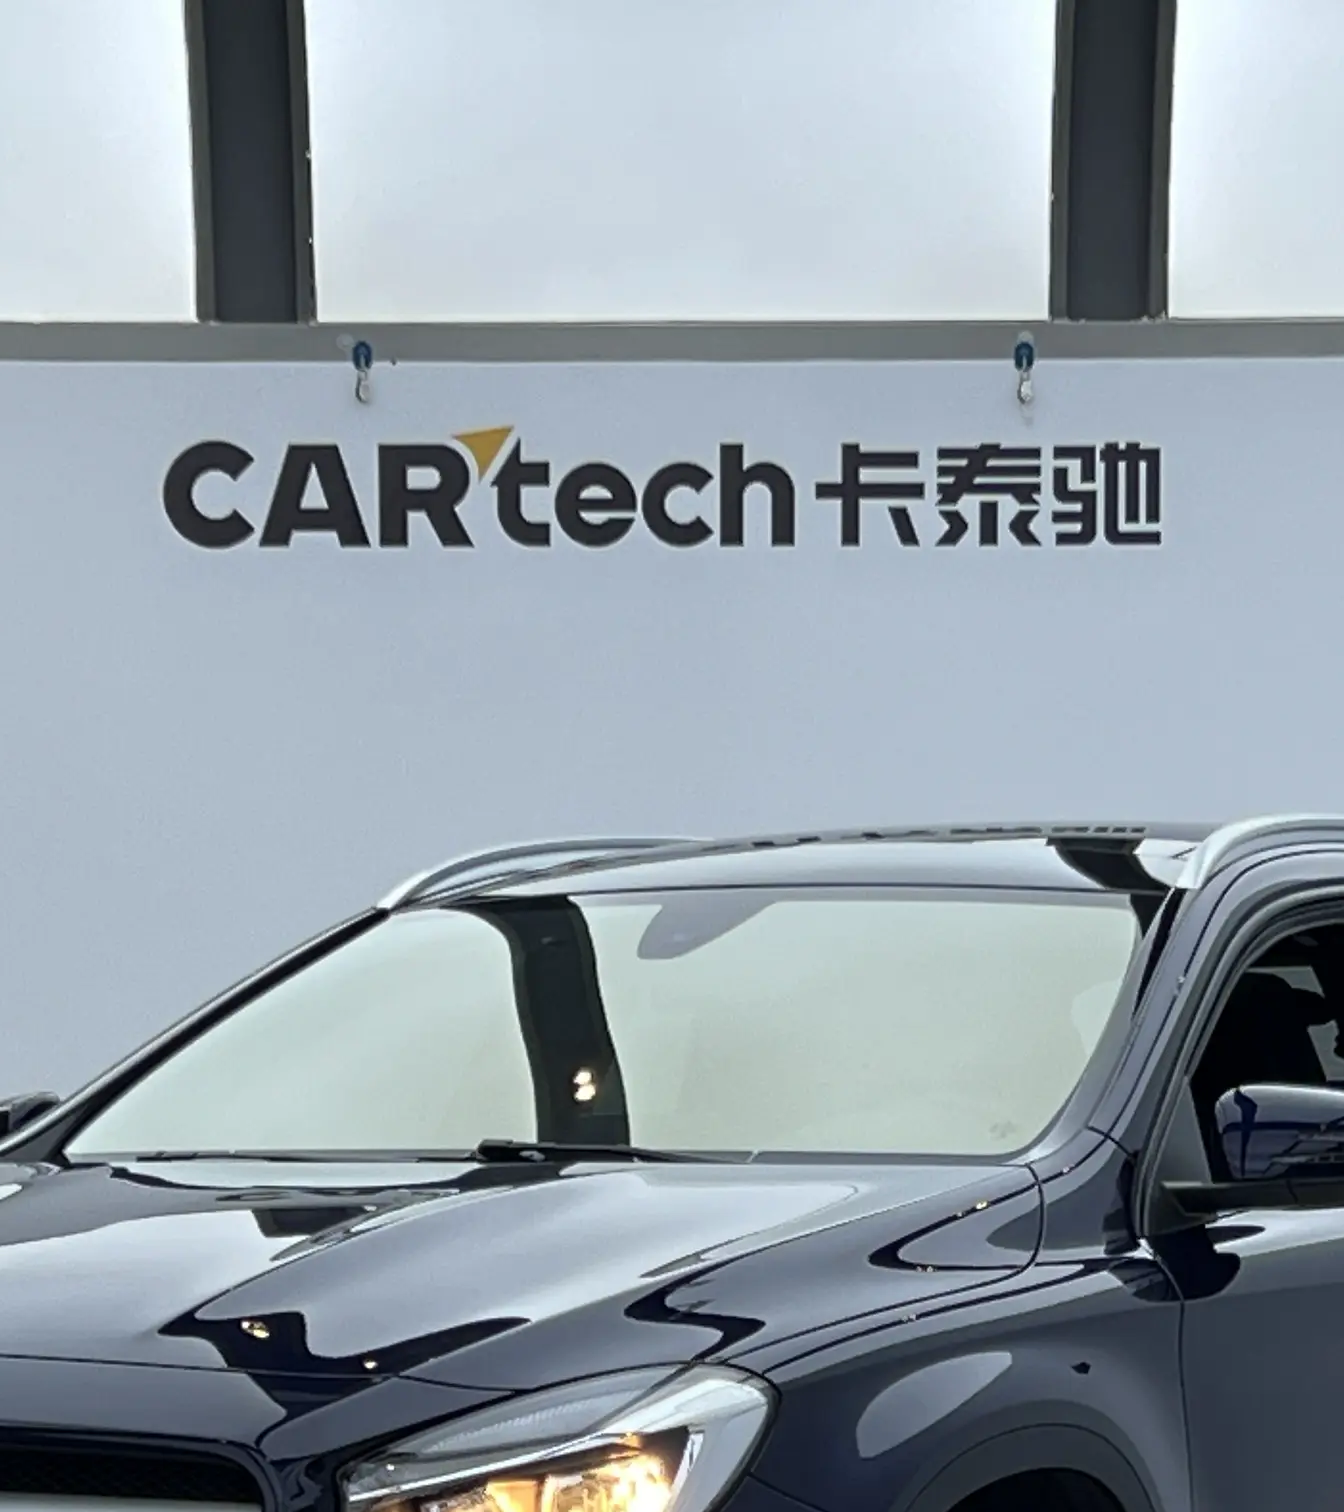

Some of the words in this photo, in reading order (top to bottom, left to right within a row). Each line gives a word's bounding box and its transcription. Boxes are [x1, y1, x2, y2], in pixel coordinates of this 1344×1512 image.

[162, 438, 796, 549] CARtech
[815, 440, 1163, 548] 卡泰驰
